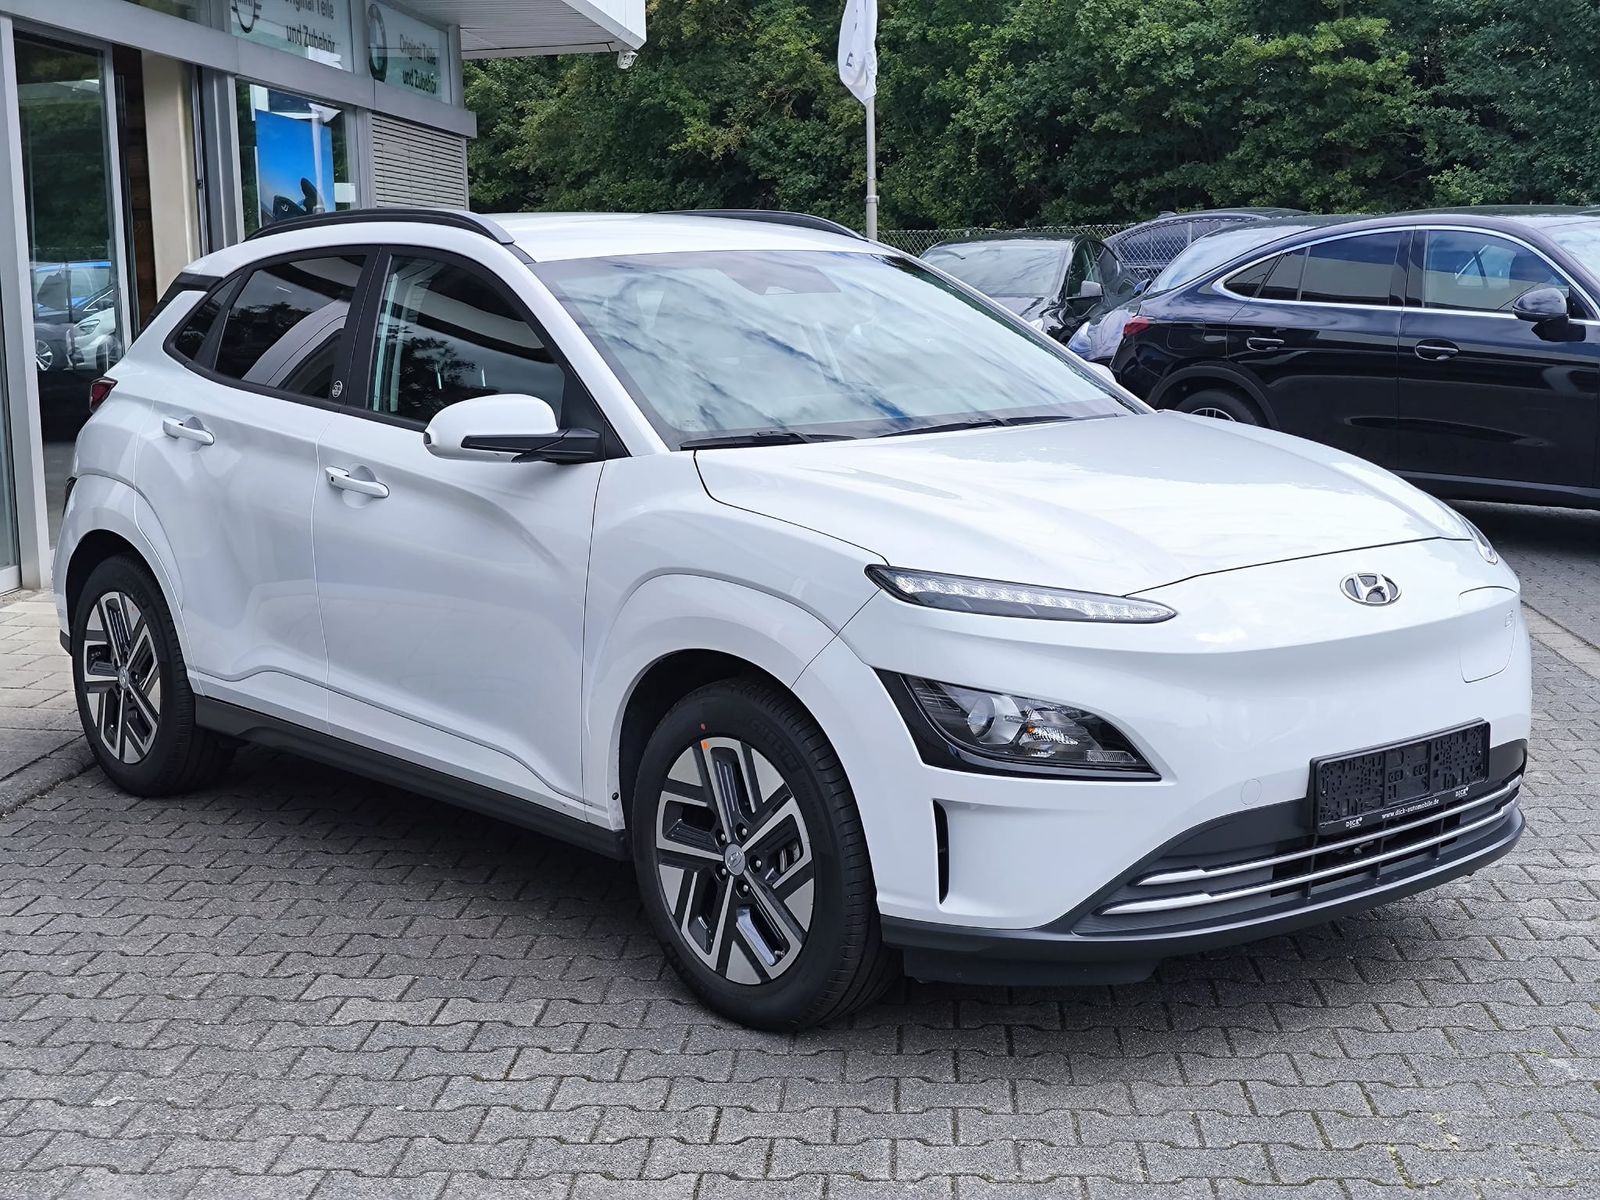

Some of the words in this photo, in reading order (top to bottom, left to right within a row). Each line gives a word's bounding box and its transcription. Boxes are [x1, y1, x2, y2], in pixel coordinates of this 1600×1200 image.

[286, 24, 303, 46] und
[303, 25, 335, 54] Zubehör
[403, 68, 414, 87] und
[1381, 798, 1440, 819] www.dick-automobile.de
